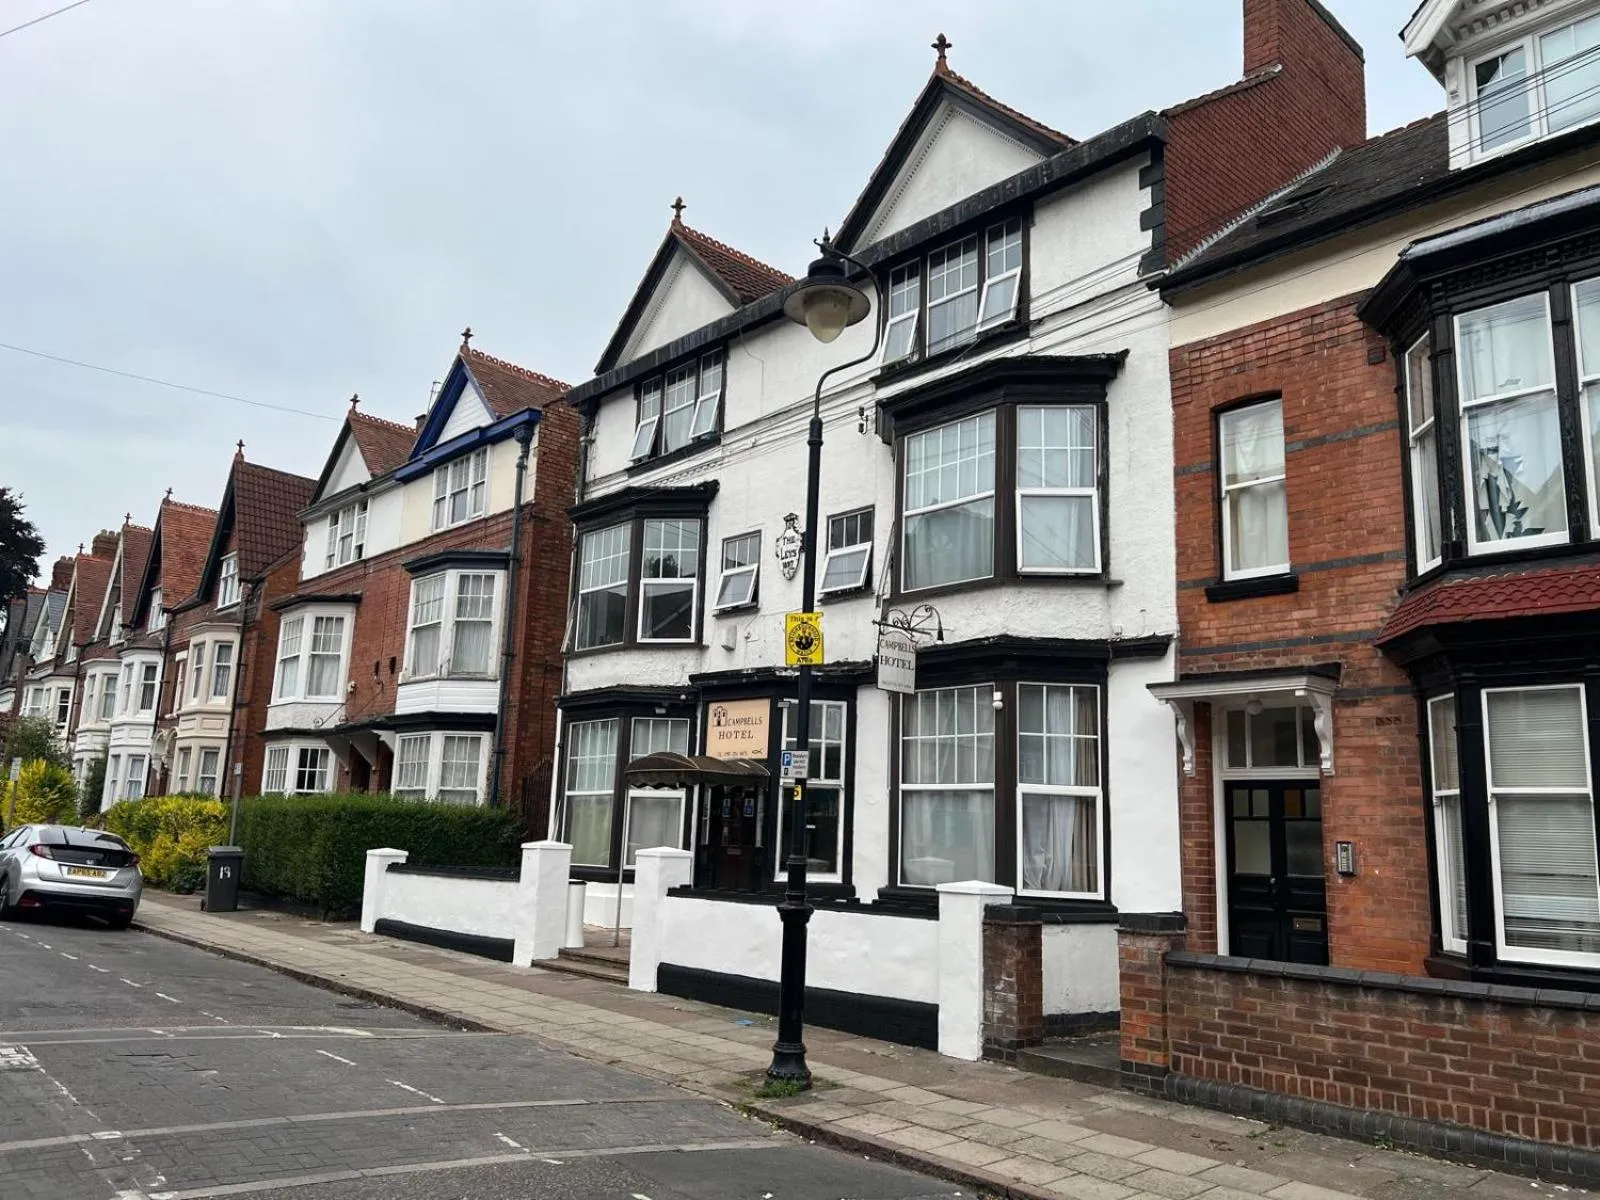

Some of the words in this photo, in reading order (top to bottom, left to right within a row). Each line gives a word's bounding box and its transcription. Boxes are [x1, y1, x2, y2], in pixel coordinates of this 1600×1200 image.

[783, 535, 796, 546] THE
[880, 639, 917, 654] CAMPBELLS
[880, 655, 915, 671] HOTEL
[727, 716, 763, 727] CAMPBELLS
[718, 730, 754, 740] HOTEL
[784, 753, 790, 765] P
[219, 865, 231, 879] 19
